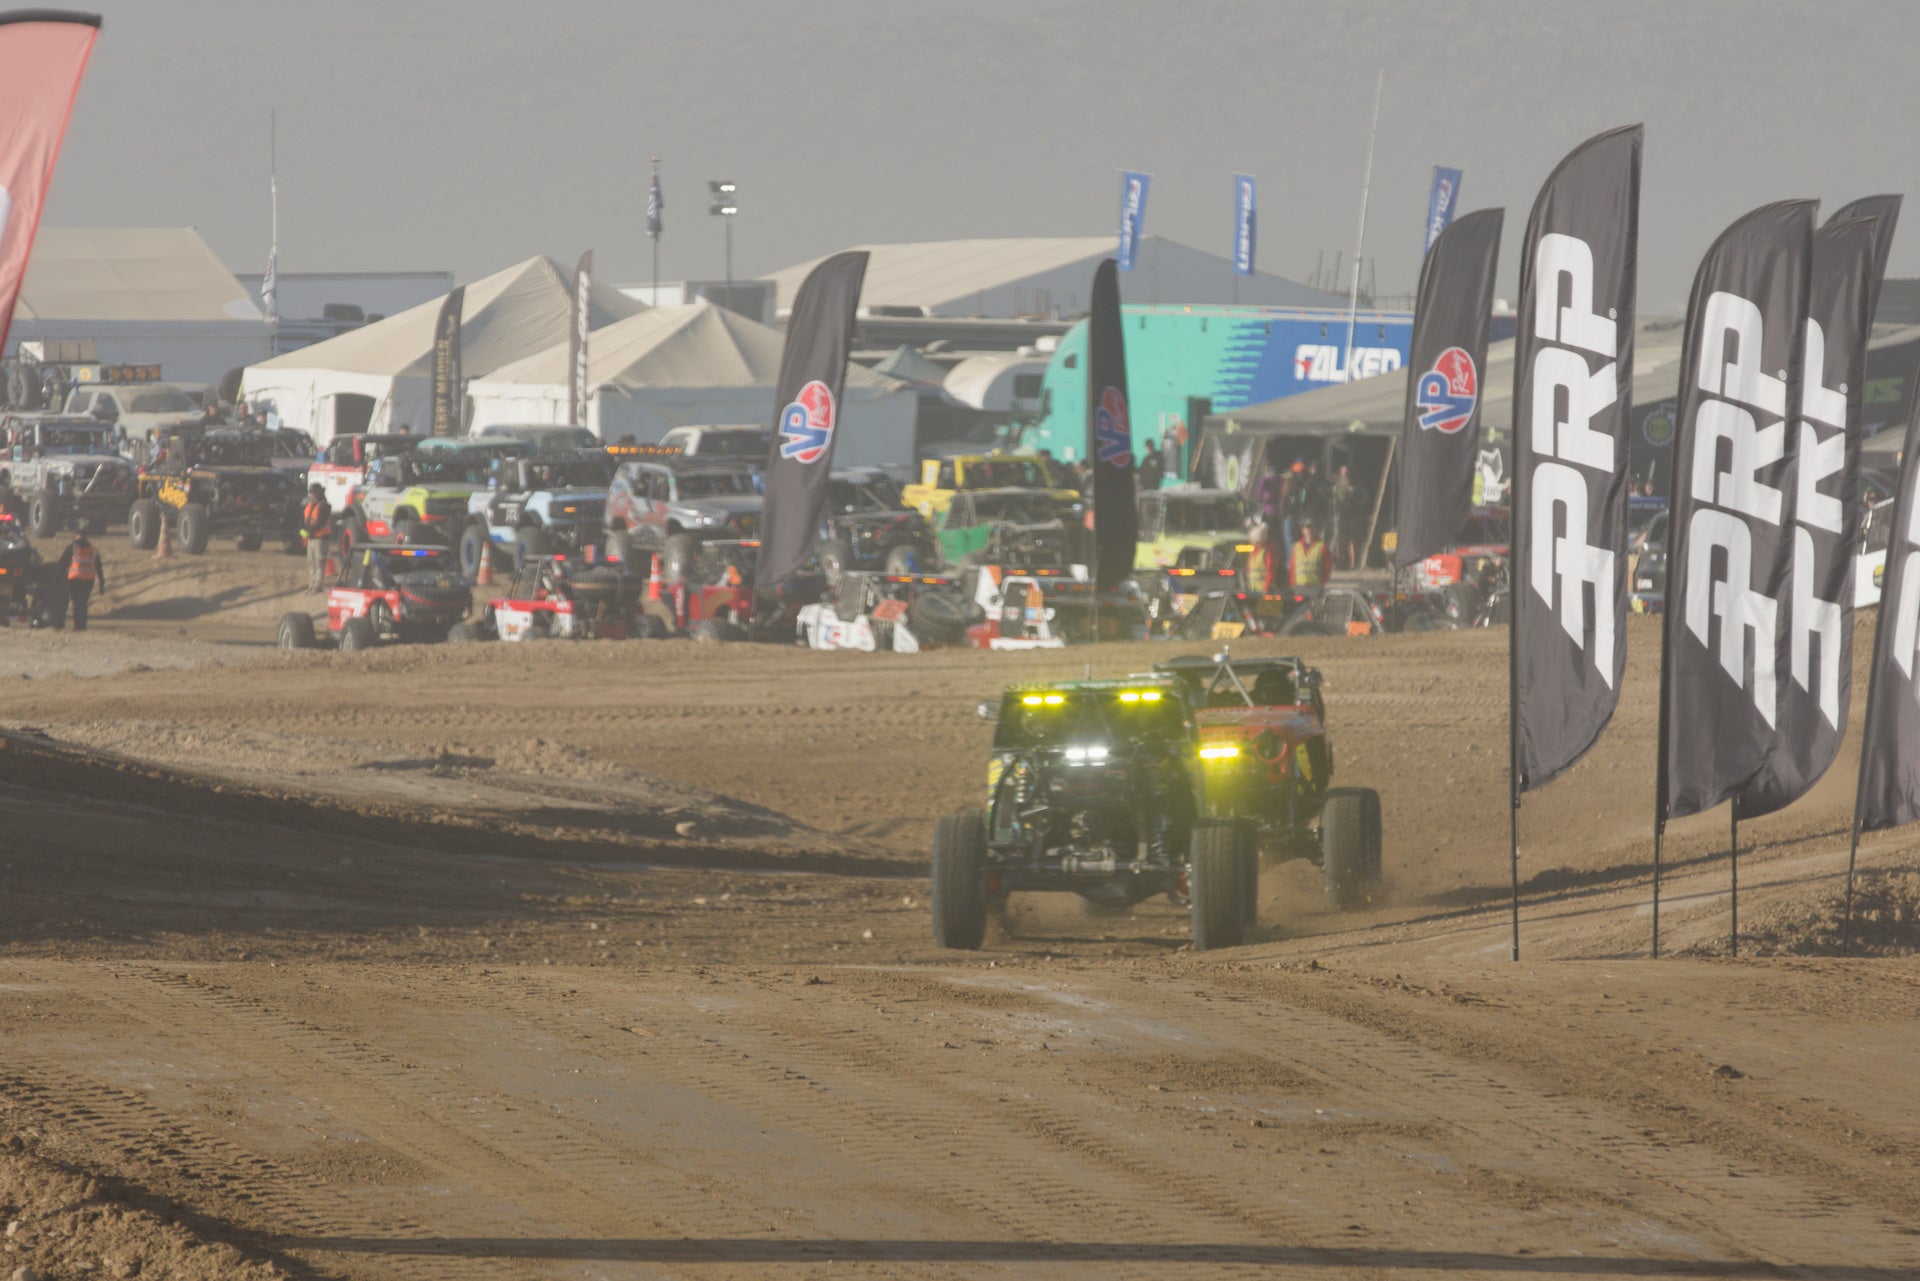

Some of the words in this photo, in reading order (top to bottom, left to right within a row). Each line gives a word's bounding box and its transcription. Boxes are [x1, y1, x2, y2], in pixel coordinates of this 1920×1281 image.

[1417, 370, 1476, 430] VP
[779, 402, 832, 460] VP
[1532, 232, 1618, 691] PRP
[158, 478, 188, 510] Jeep
[1685, 291, 1787, 732] PRP
